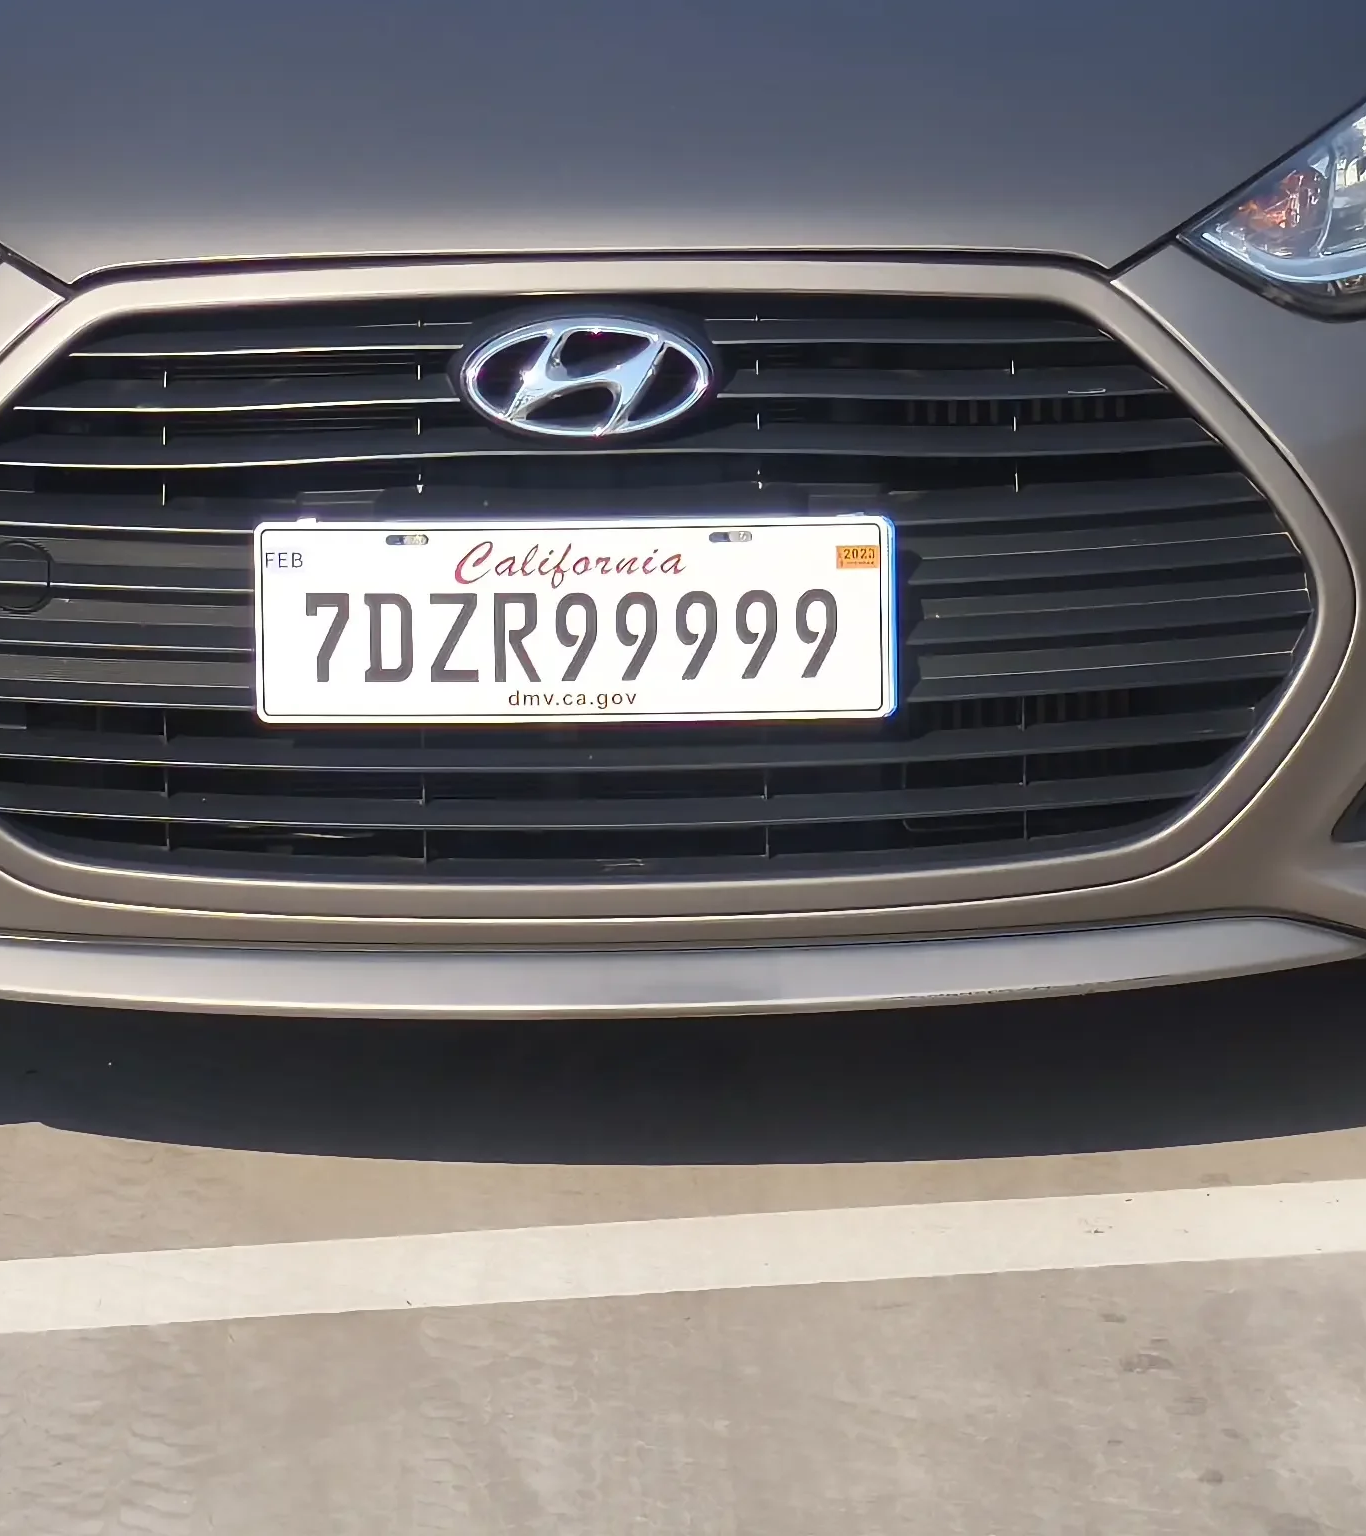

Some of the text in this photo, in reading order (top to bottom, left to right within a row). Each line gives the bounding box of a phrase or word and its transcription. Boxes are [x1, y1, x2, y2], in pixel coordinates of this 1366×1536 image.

[264, 551, 304, 569] FEB
[453, 540, 687, 589] California
[305, 588, 839, 683] 7DZR99999
[507, 689, 638, 711] dmv.ca.gov
